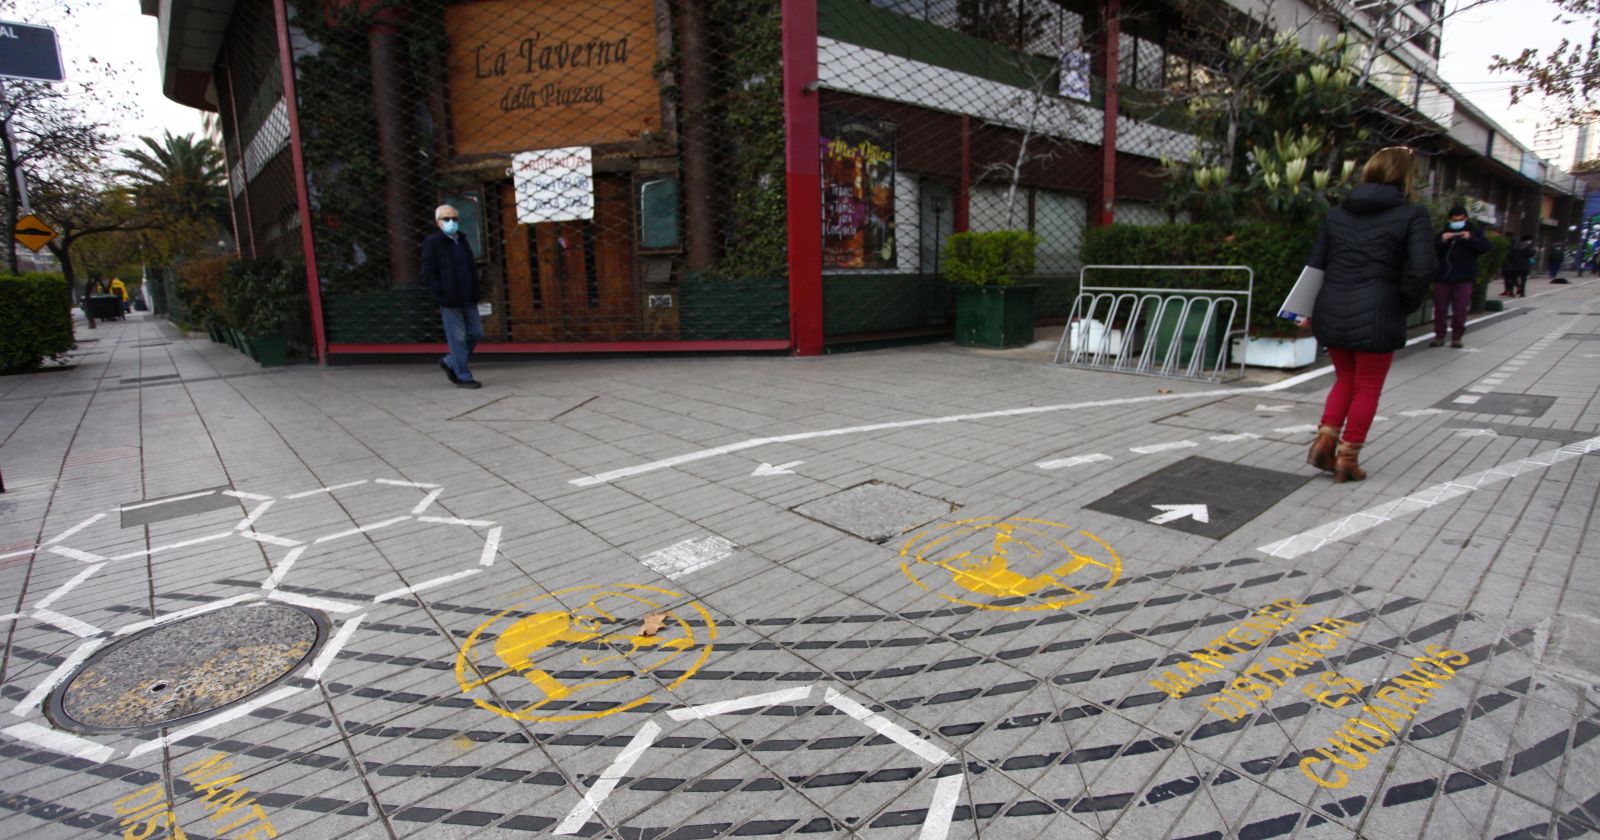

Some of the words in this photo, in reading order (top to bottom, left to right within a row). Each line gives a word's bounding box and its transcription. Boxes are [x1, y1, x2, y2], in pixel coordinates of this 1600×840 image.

[474, 45, 507, 79] La
[519, 33, 628, 74] Taverna
[501, 83, 535, 112] della
[541, 82, 604, 107] Piazza
[1149, 597, 1312, 699] MANTENER
[1203, 616, 1360, 723] DISTANCIA
[1299, 643, 1470, 790] CUIDARNOS
[1302, 671, 1365, 710] ES
